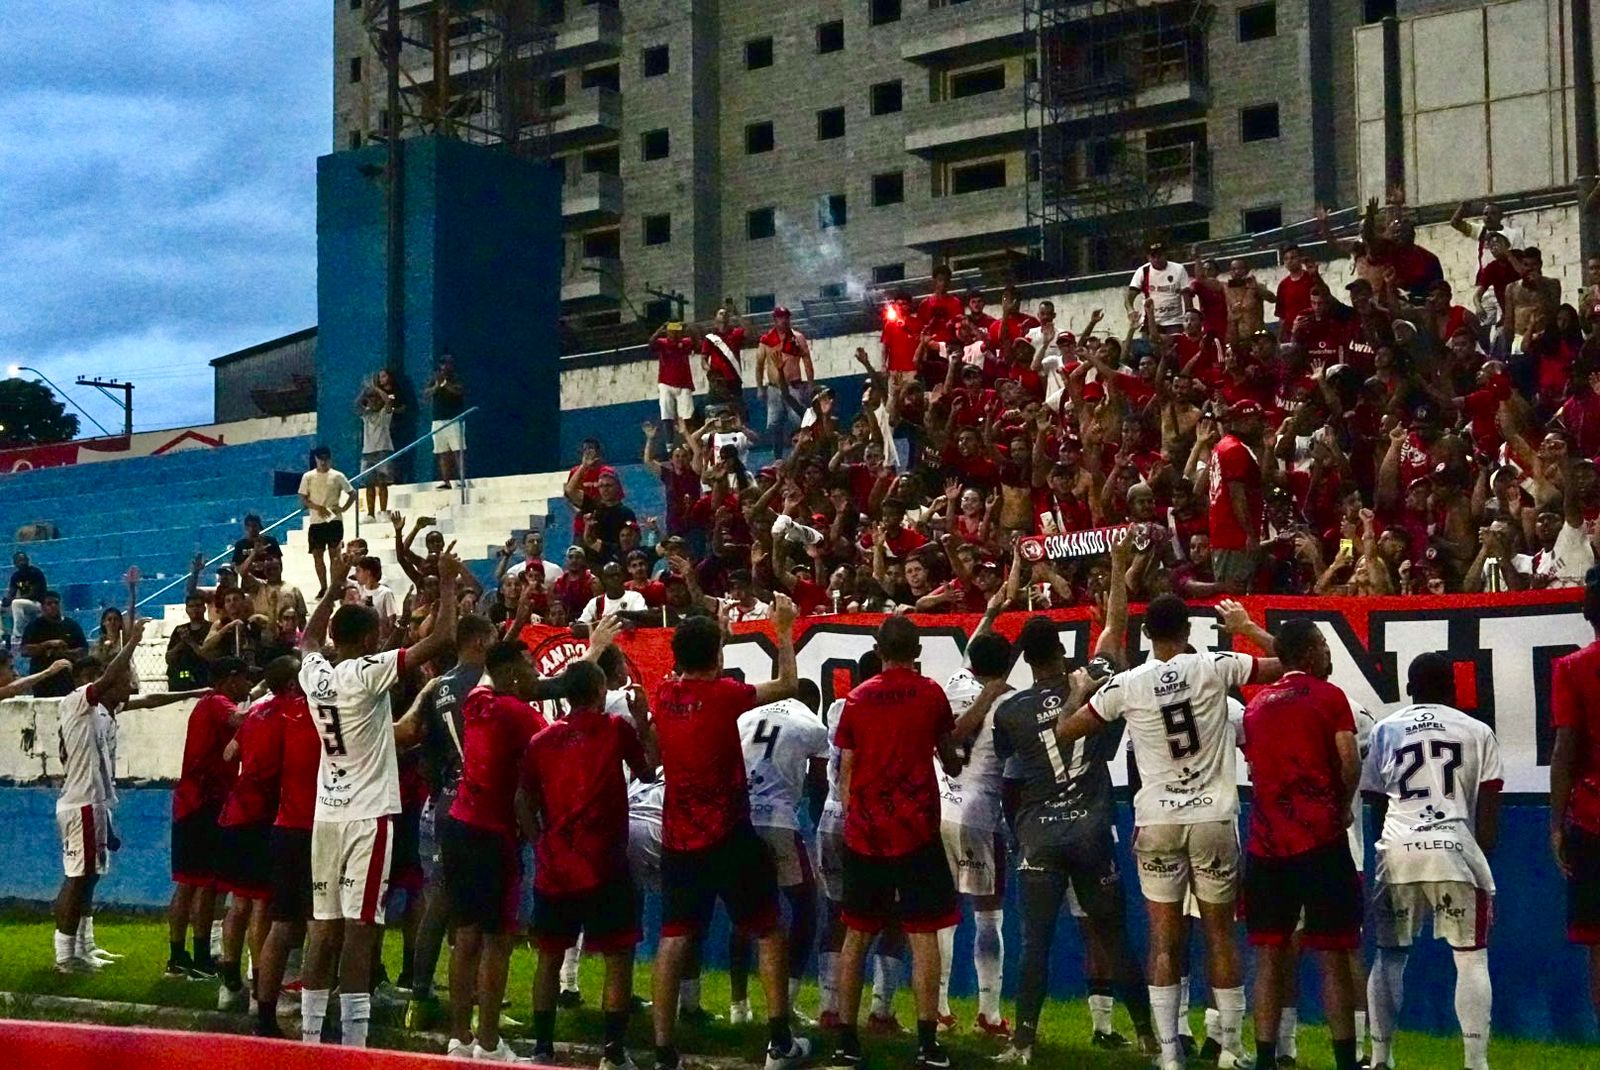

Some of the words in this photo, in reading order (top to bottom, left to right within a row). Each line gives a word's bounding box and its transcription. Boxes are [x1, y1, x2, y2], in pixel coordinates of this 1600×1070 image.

[1044, 530, 1105, 560] COMANDO
[1154, 680, 1189, 694] SAMPEL
[317, 704, 348, 757] 3
[754, 719, 782, 760] 4
[1160, 699, 1201, 760] 9
[1405, 722, 1446, 733] SAMPEL
[1394, 739, 1463, 803] 27
